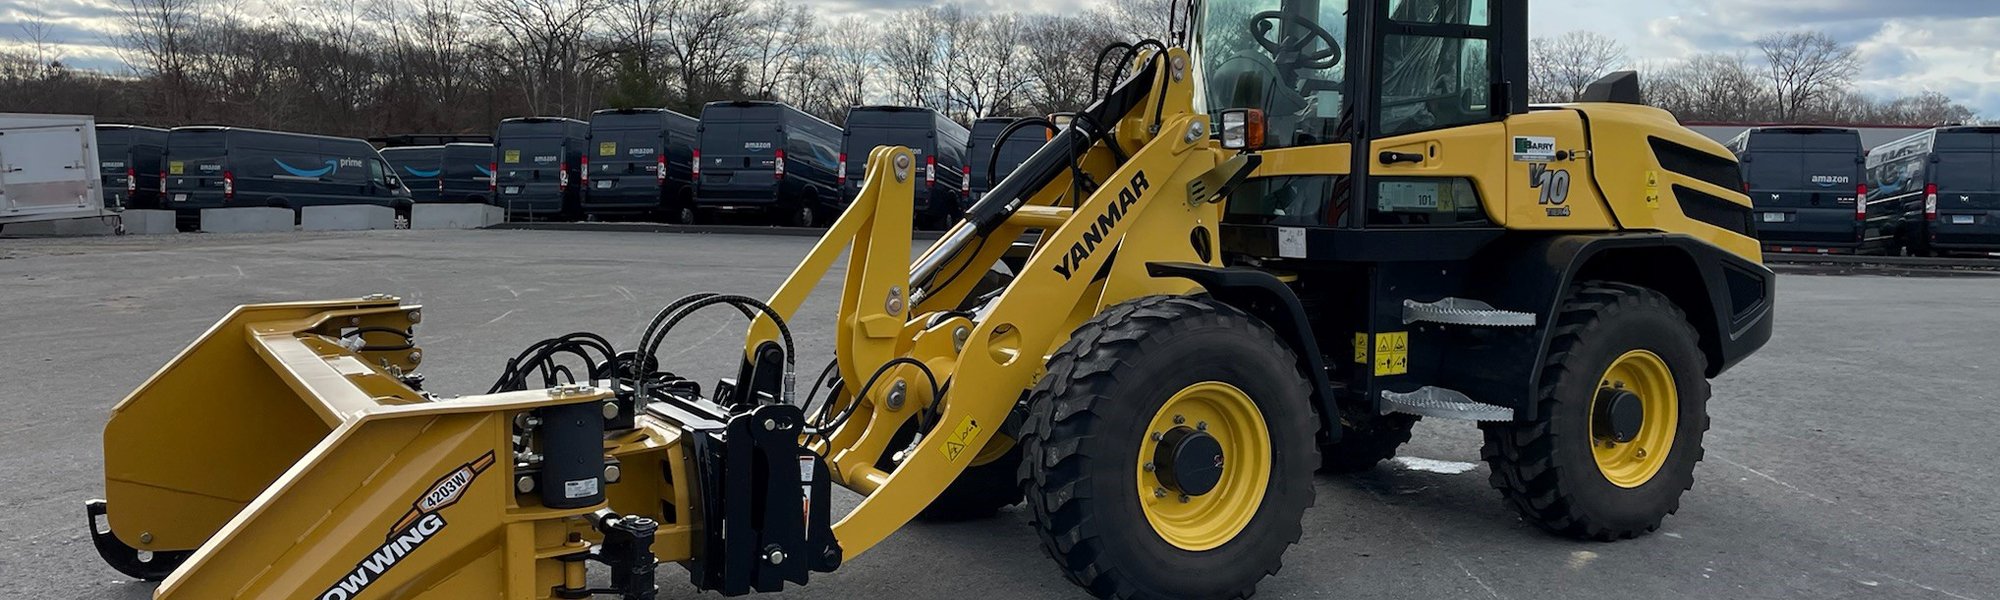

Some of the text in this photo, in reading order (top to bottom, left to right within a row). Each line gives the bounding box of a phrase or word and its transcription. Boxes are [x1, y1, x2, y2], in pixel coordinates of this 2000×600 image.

[1525, 141, 1554, 150] BARRY
[340, 157, 362, 168] prime
[1812, 175, 1849, 183] amazon
[1418, 194, 1432, 206] 101
[1053, 169, 1150, 281] YANMAR
[426, 471, 467, 508] 4203W
